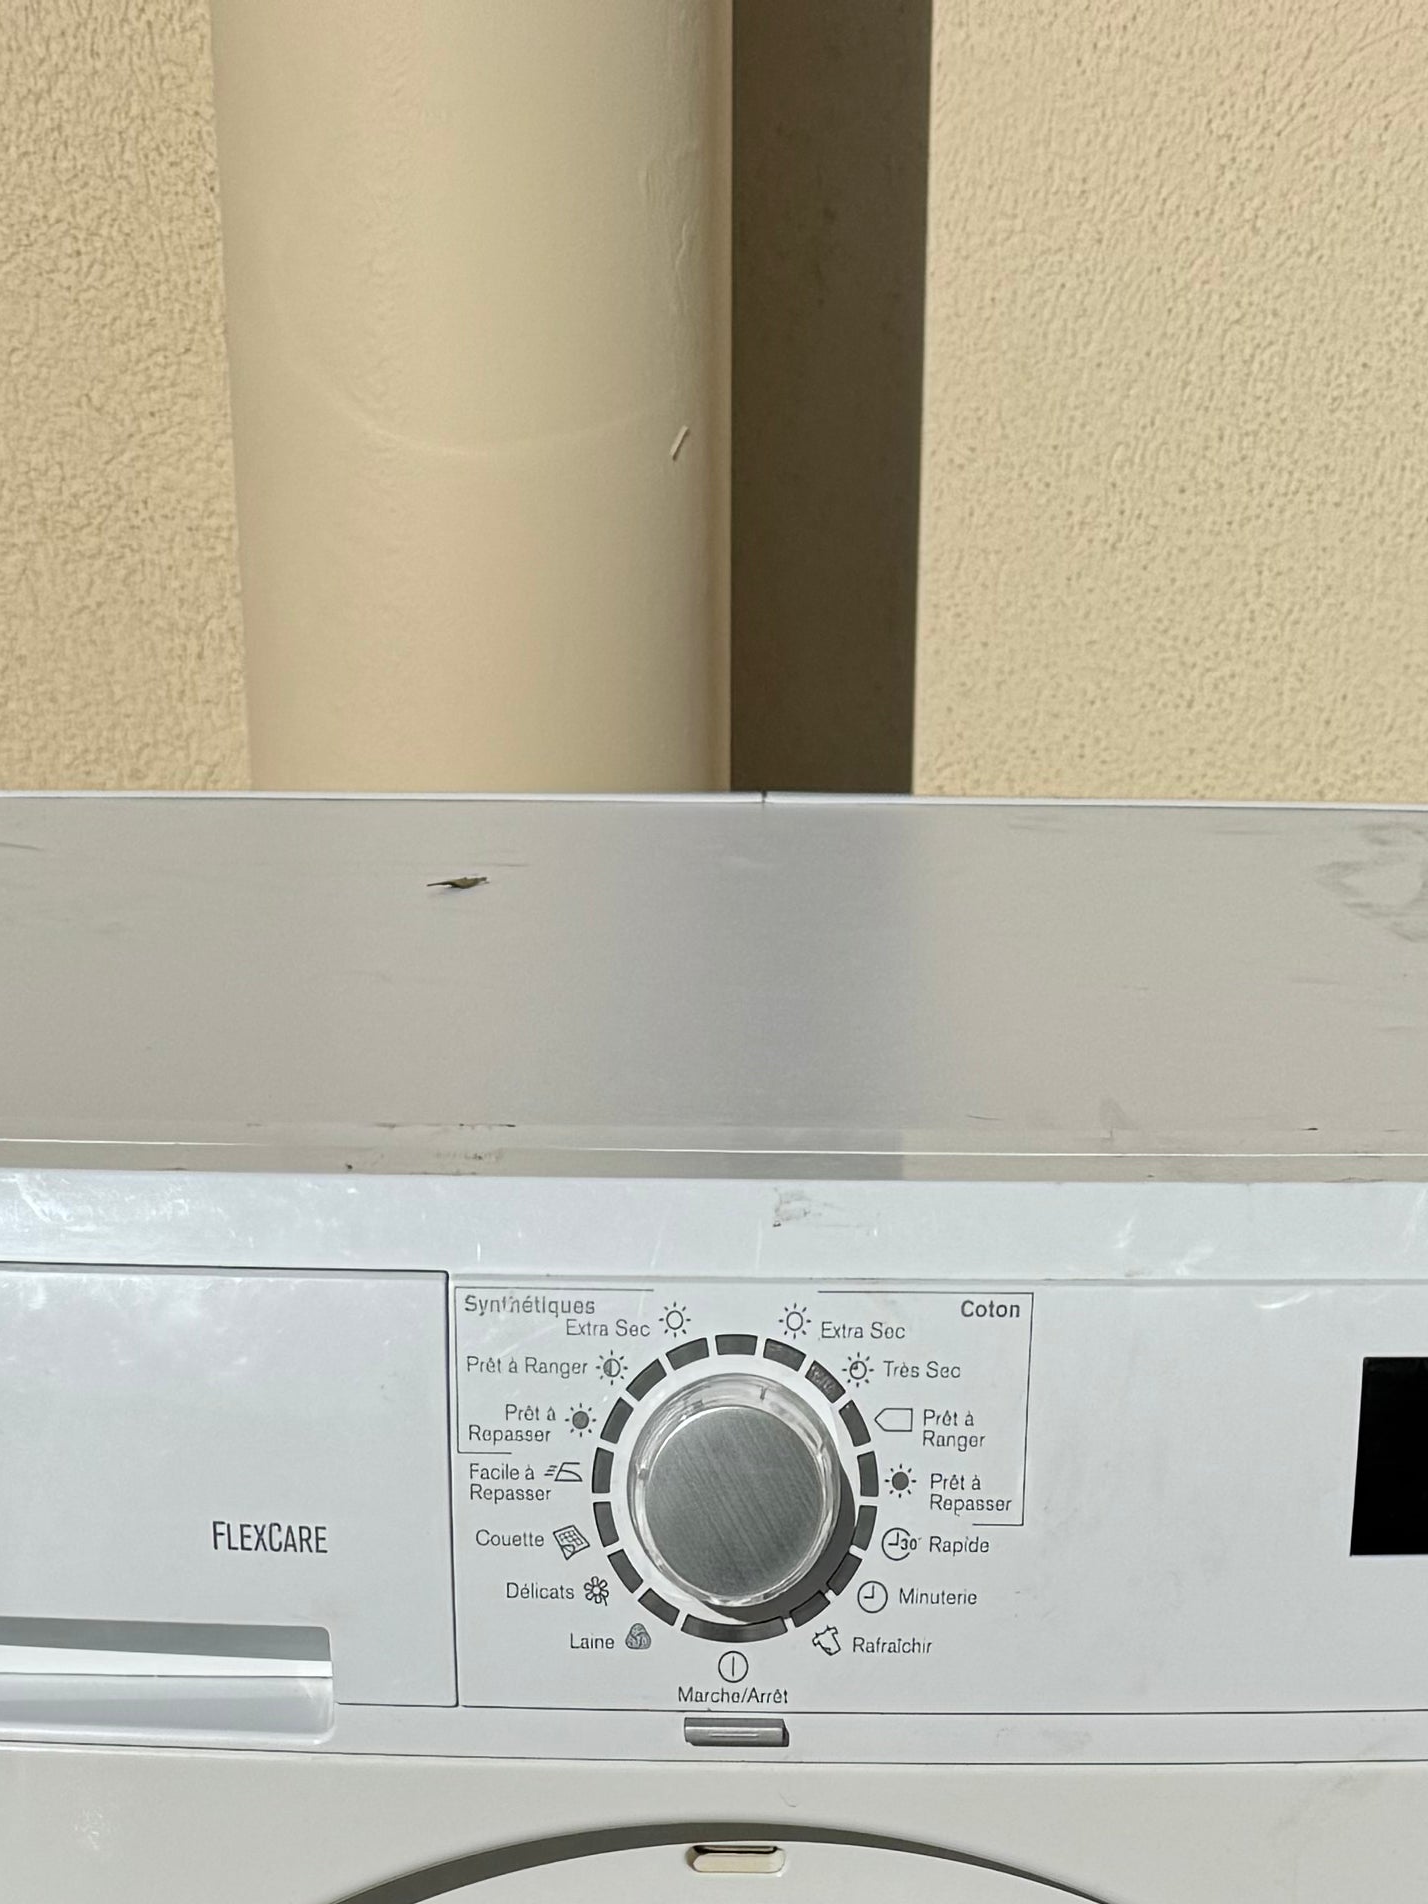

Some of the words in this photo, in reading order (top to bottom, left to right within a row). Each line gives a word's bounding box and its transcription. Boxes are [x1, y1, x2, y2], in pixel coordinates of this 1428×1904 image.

[960, 1299, 1021, 1320] Coton
[565, 1319, 612, 1338] Extra
[614, 1319, 651, 1337] Sec
[819, 1321, 866, 1340] Extra
[869, 1322, 906, 1340] Sec
[466, 1356, 503, 1376] Prêt
[508, 1357, 518, 1374] à
[523, 1358, 589, 1380] Ranger
[882, 1359, 921, 1380] Très
[924, 1361, 962, 1380] Sec
[504, 1402, 541, 1423] Prêt
[546, 1404, 557, 1422] à
[922, 1408, 959, 1429] Prêt
[962, 1409, 974, 1429] à
[467, 1424, 551, 1446] Repasser
[921, 1430, 985, 1451] Ranger
[468, 1463, 519, 1482] Facile
[524, 1464, 536, 1482] à
[929, 1472, 965, 1492] Prêt
[970, 1473, 982, 1492] à
[468, 1483, 552, 1504] Repasser
[928, 1493, 1013, 1515] Repasser
[211, 1519, 329, 1556] FLEXCARE
[474, 1529, 545, 1549] Couette
[928, 1536, 990, 1558] Rapide
[505, 1580, 575, 1601] Délicats
[898, 1587, 978, 1607] Minuterie
[569, 1632, 615, 1651] Laine
[851, 1635, 933, 1656] Rafraîchir
[677, 1685, 789, 1705] Marche/Arrêt
